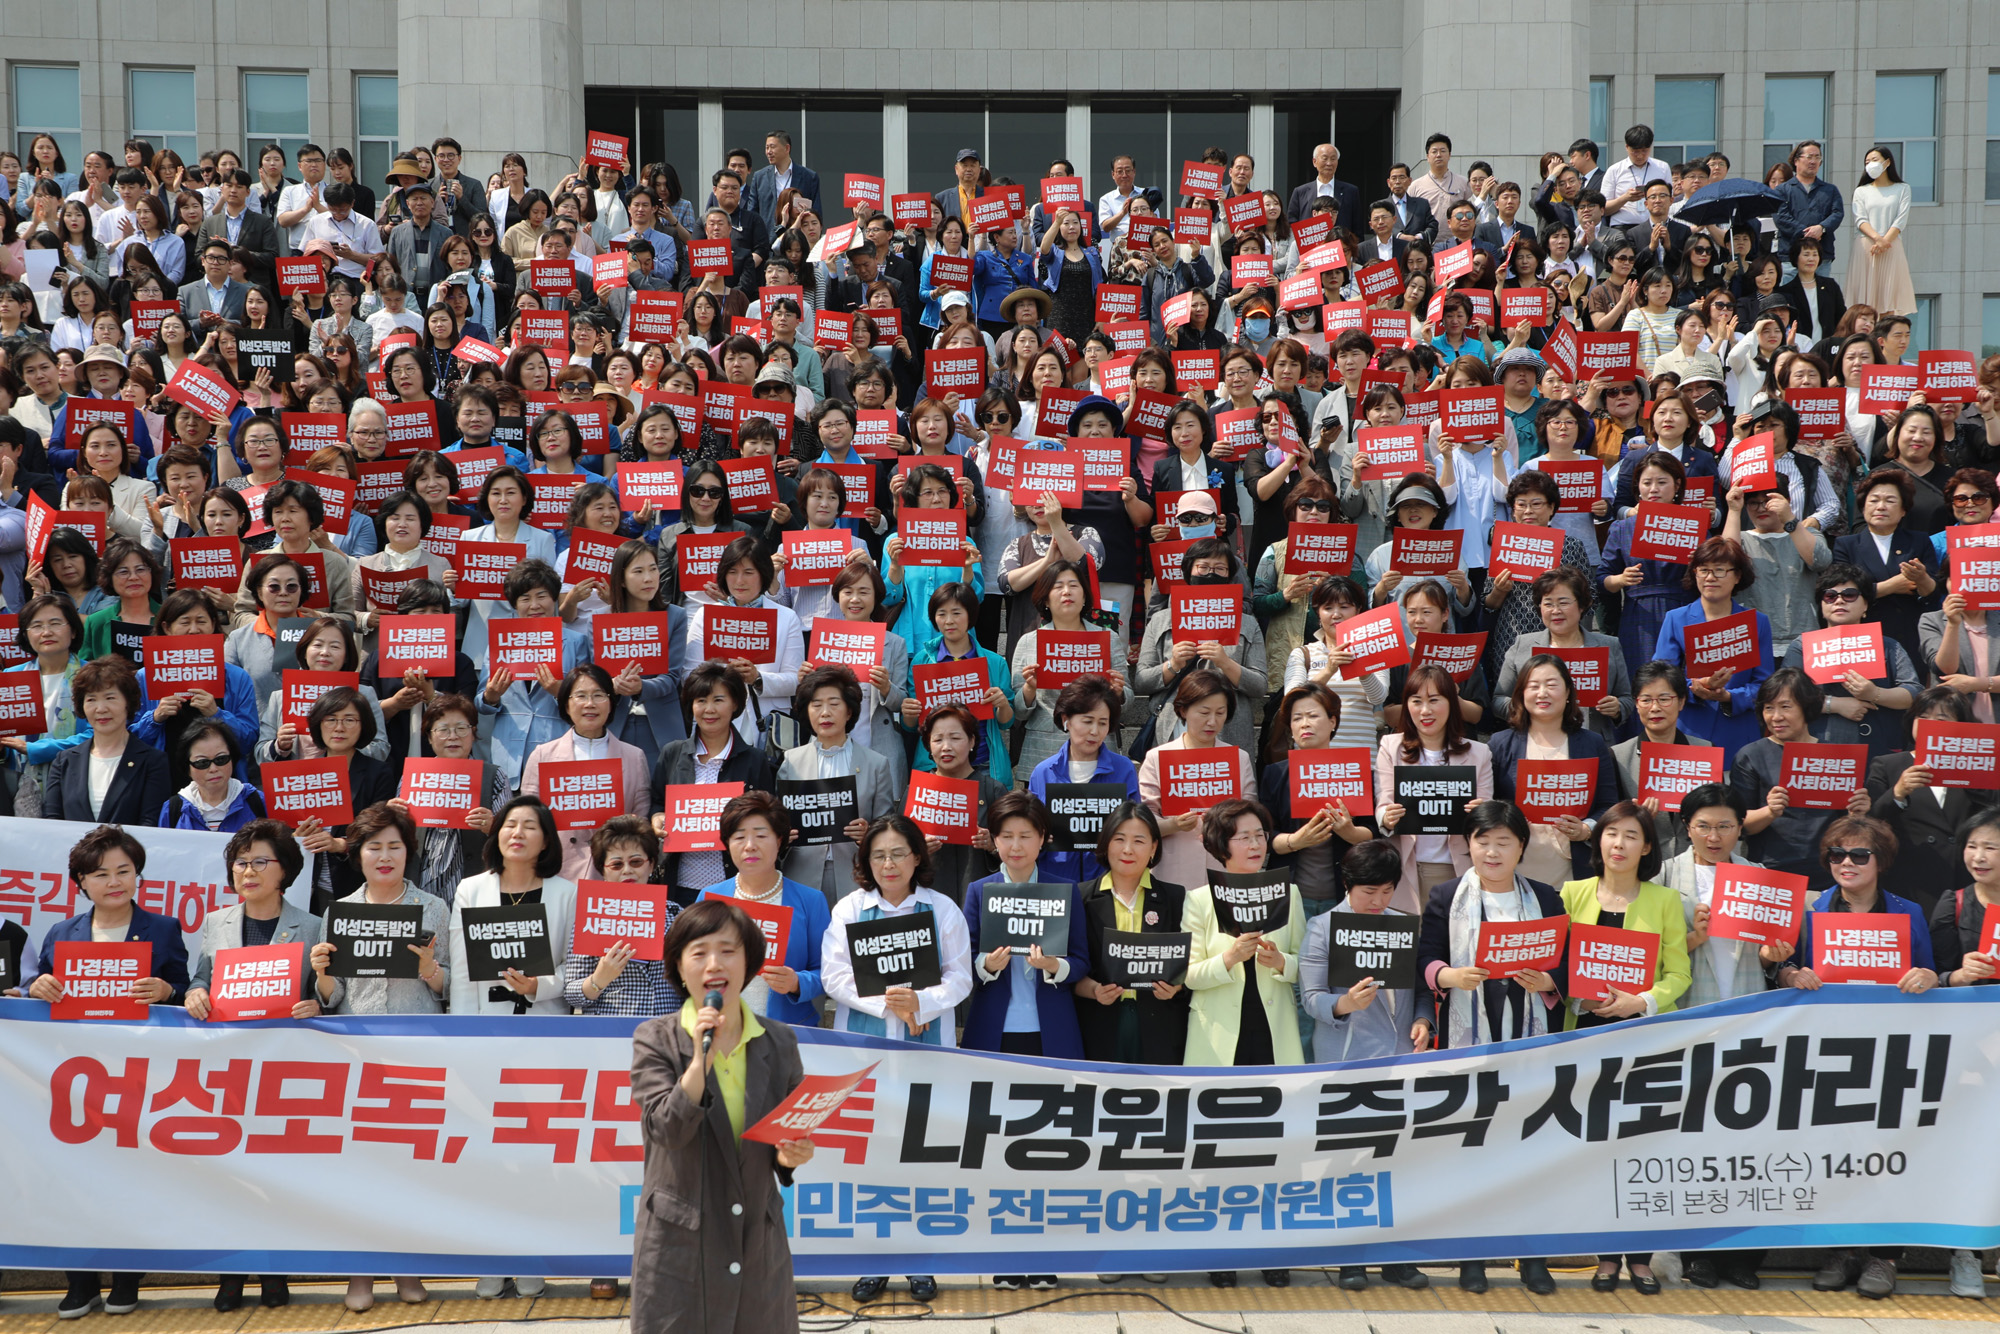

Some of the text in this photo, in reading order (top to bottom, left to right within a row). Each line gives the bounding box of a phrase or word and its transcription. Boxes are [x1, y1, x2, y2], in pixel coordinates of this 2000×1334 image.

[593, 139, 622, 151] 나경원은
[590, 148, 622, 161] 사퇴하라!
[1047, 184, 1077, 193] 나경원은
[896, 200, 925, 210] 나경원은
[1047, 193, 1079, 203] 사퇴하라!
[896, 210, 927, 219] 사퇴하라!
[974, 201, 1005, 214] 나경원은
[974, 210, 1008, 224] 사퇴하라!
[693, 247, 726, 257] 나경원은
[282, 264, 314, 274] 나경원은
[694, 257, 728, 266] 사퇴하라!
[937, 262, 968, 273] 나경원은
[1237, 261, 1267, 270] 나경원은
[283, 275, 319, 284] 사퇴하라!
[536, 268, 569, 276] 나경원은
[935, 271, 968, 282] 사퇴하라!
[1236, 270, 1271, 280] 사퇴하라!
[536, 278, 571, 286] 사퇴하라!
[1102, 293, 1135, 303] 나경원은
[1507, 296, 1541, 306] 나경원은
[636, 313, 671, 323] 나경원은
[1328, 309, 1360, 320] 나경원은
[1505, 307, 1542, 316] 사퇴하라!
[527, 319, 562, 328] 나경원은
[634, 324, 672, 334] 사퇴하라!
[1327, 319, 1362, 330] 사퇴하라!
[239, 340, 291, 353] 여성모독발언
[1584, 342, 1630, 355] 나경원은
[251, 355, 276, 367] OUT!
[933, 359, 977, 372] 나경원은
[1178, 359, 1213, 369] 나경원은
[1582, 356, 1630, 368] 사퇴하라!
[1927, 361, 1973, 374] 나경원은
[932, 373, 979, 386] 사퇴하라!
[1176, 370, 1215, 380] 사퇴하라!
[1924, 376, 1977, 390] 사퇴하라!
[1449, 398, 1496, 412] 나경원은
[1448, 412, 1498, 427] 사퇴하라!
[291, 425, 338, 437] 나경원은
[1366, 436, 1414, 450] 나경원은
[1023, 462, 1074, 477] 나경원은
[626, 472, 675, 483] 나경원은
[626, 485, 678, 496] 사퇴하라!
[1020, 478, 1076, 493] 사퇴하라!
[907, 521, 957, 534] 나경원은
[1645, 515, 1699, 533] 나경원은
[905, 537, 959, 550] 사퇴하라!
[1296, 535, 1347, 548] 나경원은
[1401, 539, 1453, 551] 나경원은
[1501, 535, 1554, 553] 나경원은
[1640, 530, 1699, 549] 사퇴하라!
[792, 541, 843, 554] 나경원은
[180, 549, 232, 563] 나경원은
[464, 554, 517, 569] 나경원은
[791, 556, 846, 570] 사퇴하라!
[1292, 549, 1347, 562] 사퇴하라!
[1397, 552, 1454, 563] 사퇴하라!
[1497, 550, 1554, 569] 사퇴하라!
[182, 564, 237, 579] 사퇴하라!
[1181, 598, 1234, 613] 나경원은
[713, 618, 767, 634] 나경원은
[1179, 615, 1235, 630] 사퇴하라!
[389, 628, 445, 642] 나경원은
[499, 631, 554, 646] 나경원은
[603, 626, 658, 641] 나경원은
[820, 632, 875, 649] 나경원은
[1695, 625, 1748, 649] 나경원은
[710, 634, 769, 650] 사퇴하라!
[1813, 635, 1872, 654] 나경원은
[154, 649, 214, 664] 나경원은
[386, 645, 447, 659] 사퇴하라!
[497, 648, 556, 663] 사퇴하라!
[602, 643, 661, 659] 사퇴하라!
[1046, 643, 1101, 657] 나경원은
[1694, 639, 1752, 666] 사퇴하라!
[815, 648, 875, 668] 사퇴하라!
[1812, 649, 1876, 668] 사퇴하라!
[1044, 659, 1103, 673] 사퇴하라!
[153, 666, 217, 682] 사퇴하라!
[1927, 736, 1995, 753] 나경원은
[1649, 758, 1711, 777] 나경원은
[1792, 758, 1856, 774] 나경원은
[1926, 754, 1995, 771] 사퇴하라!
[1170, 762, 1229, 779] 나경원은
[1300, 763, 1360, 779] 나경원은
[273, 772, 338, 792] 나경원은
[411, 773, 470, 790] 나경원은
[550, 774, 612, 792] 나경원은
[1169, 780, 1232, 797] 사퇴하라!
[1400, 781, 1471, 796] 여성모독발언
[1527, 773, 1588, 789] 나경원은
[1787, 775, 1855, 794] 사퇴하라!
[1299, 781, 1363, 798] 사퇴하라!
[274, 790, 343, 810] 사퇴하라!
[407, 791, 471, 809] 사퇴하라!
[549, 793, 615, 811] 사퇴하라!
[783, 790, 852, 811] 여성모독발언
[915, 787, 967, 809] 나경원은
[1523, 791, 1588, 806] 사퇴하라!
[1419, 800, 1452, 815] OUT!
[802, 811, 835, 827] OUT!
[910, 805, 969, 827] 사퇴하라!
[1070, 817, 1102, 832] OUT!
[1214, 883, 1285, 904] 여성모독발언
[1724, 880, 1792, 907] 나경원은
[587, 897, 654, 918] 나경원은
[989, 897, 1065, 916] 여성모독발언
[1233, 905, 1267, 922] OUT!
[1718, 900, 1792, 927] 사퇴하라!
[334, 919, 416, 937] 여성모독발언
[469, 920, 543, 940] 여성모독발언
[583, 917, 655, 938] 사퇴하라!
[1008, 918, 1044, 936] OUT!
[855, 928, 931, 956] 여성모독발언
[1336, 929, 1413, 948] 여성모독발언
[1489, 929, 1556, 947] 나경원은
[1825, 929, 1897, 947] 나경원은
[354, 940, 392, 957] OUT!
[491, 941, 525, 959] OUT!
[1109, 943, 1185, 959] 여성모독발언
[1484, 944, 1556, 963] 사퇴하라!
[1580, 941, 1645, 965] 나경원은
[877, 952, 914, 973] OUT!
[1356, 951, 1392, 968] OUT!
[1822, 950, 1900, 968] 사퇴하라!
[65, 959, 138, 976] 나경원은
[223, 959, 289, 980] 나경원은
[1128, 961, 1163, 974] OUT!
[1577, 961, 1645, 988] 사퇴하라!
[217, 979, 291, 999] 사퇴하라!
[49, 1056, 469, 1164] 여성모독,
[900, 1082, 1284, 1171] 나경원은
[1316, 1070, 1510, 1160] 즉각
[1521, 1034, 1952, 1143] 사퇴하라!
[1627, 1151, 1907, 1184] 2019.5.15.(수) 14:00
[988, 1171, 1392, 1236] 전국여성위원회
[1627, 1185, 1818, 1217] 국회 본청 계단 앞
